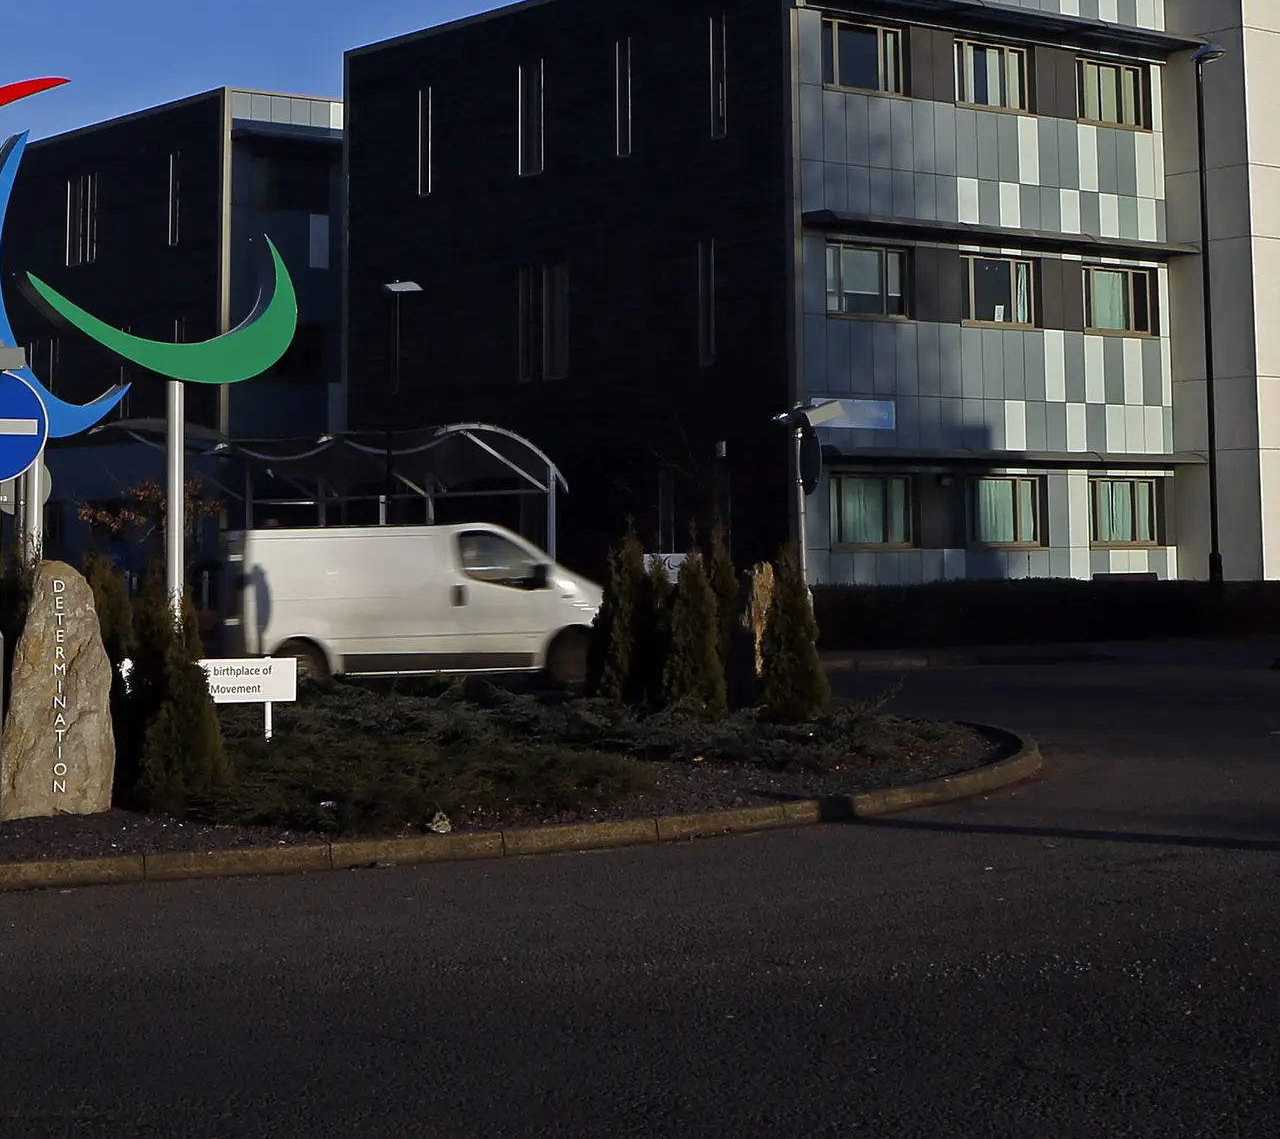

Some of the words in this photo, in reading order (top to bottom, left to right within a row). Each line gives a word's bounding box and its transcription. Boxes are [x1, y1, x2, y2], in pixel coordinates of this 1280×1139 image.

[213, 666, 260, 677] birthplace
[262, 665, 273, 676] of
[52, 580, 67, 793] DETERMINATION
[210, 684, 261, 694] Movement
